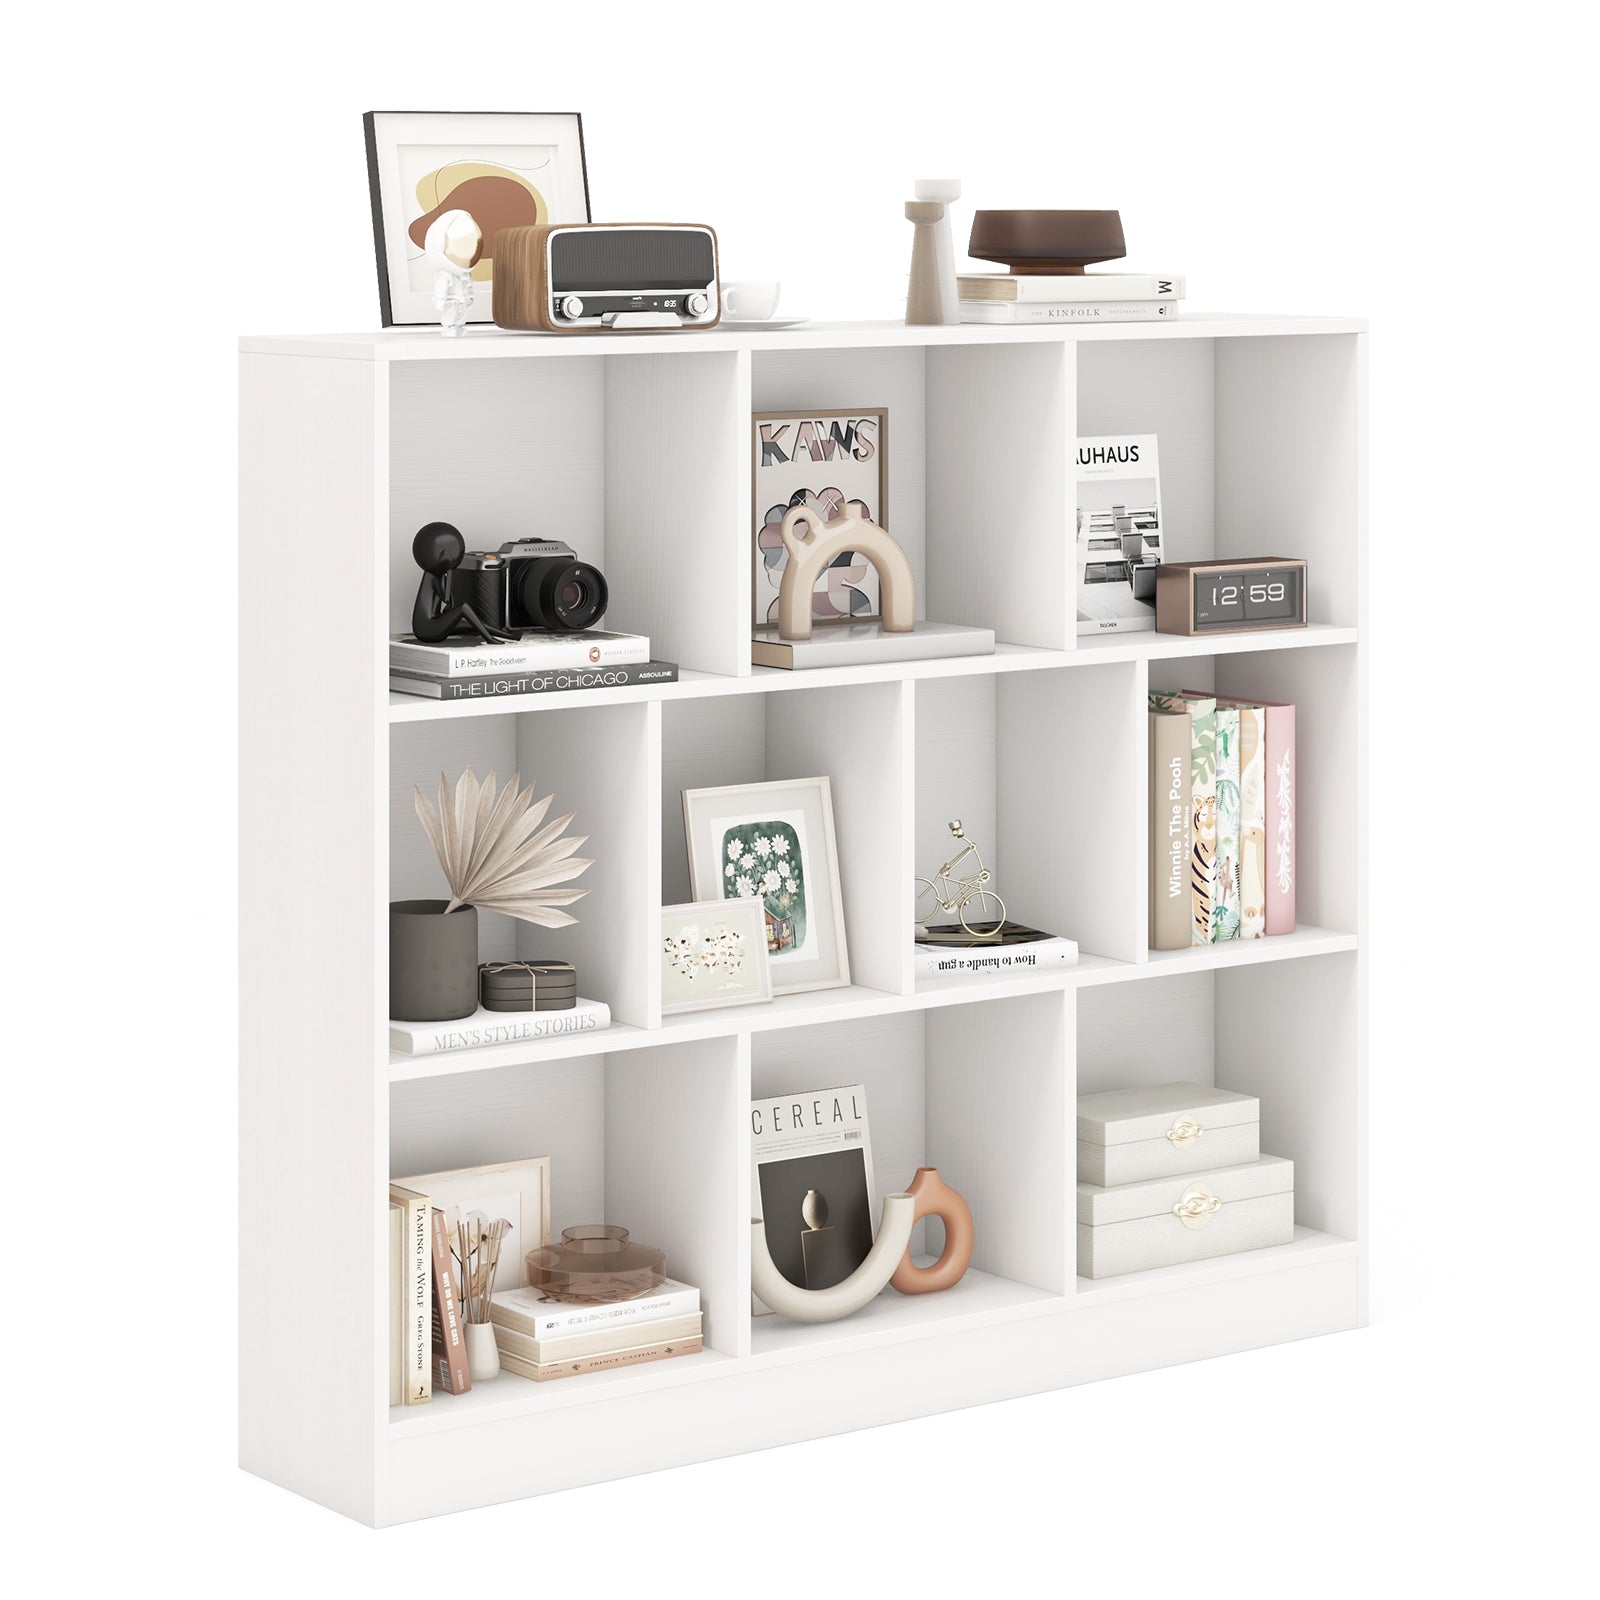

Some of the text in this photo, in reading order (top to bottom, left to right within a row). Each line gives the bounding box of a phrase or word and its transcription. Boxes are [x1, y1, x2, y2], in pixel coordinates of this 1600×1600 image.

[1158, 280, 1172, 294] M
[1048, 308, 1101, 317] KINFOLK
[759, 418, 877, 467] KAWS
[1076, 445, 1139, 465] UHAUS
[450, 671, 629, 697] THE LIGHT OF CHICAGO
[638, 670, 673, 680] ASSOULINE
[1169, 757, 1182, 898] Winnie The Pooh
[1184, 850, 1190, 861] by
[959, 959, 965, 968] a
[966, 957, 1000, 971] handle
[1002, 956, 1012, 966] to
[1014, 954, 1036, 966] How
[433, 1012, 597, 1051] MEN'S STYLE STORIES
[751, 1095, 862, 1135] CEREAL
[416, 1204, 426, 1308] TAMING the WOLF
[442, 1271, 459, 1346] WHY DO WE LOVE CATS
[416, 1315, 425, 1371] GREG STONE
[589, 1350, 658, 1367] PRINCE CASPIAN
